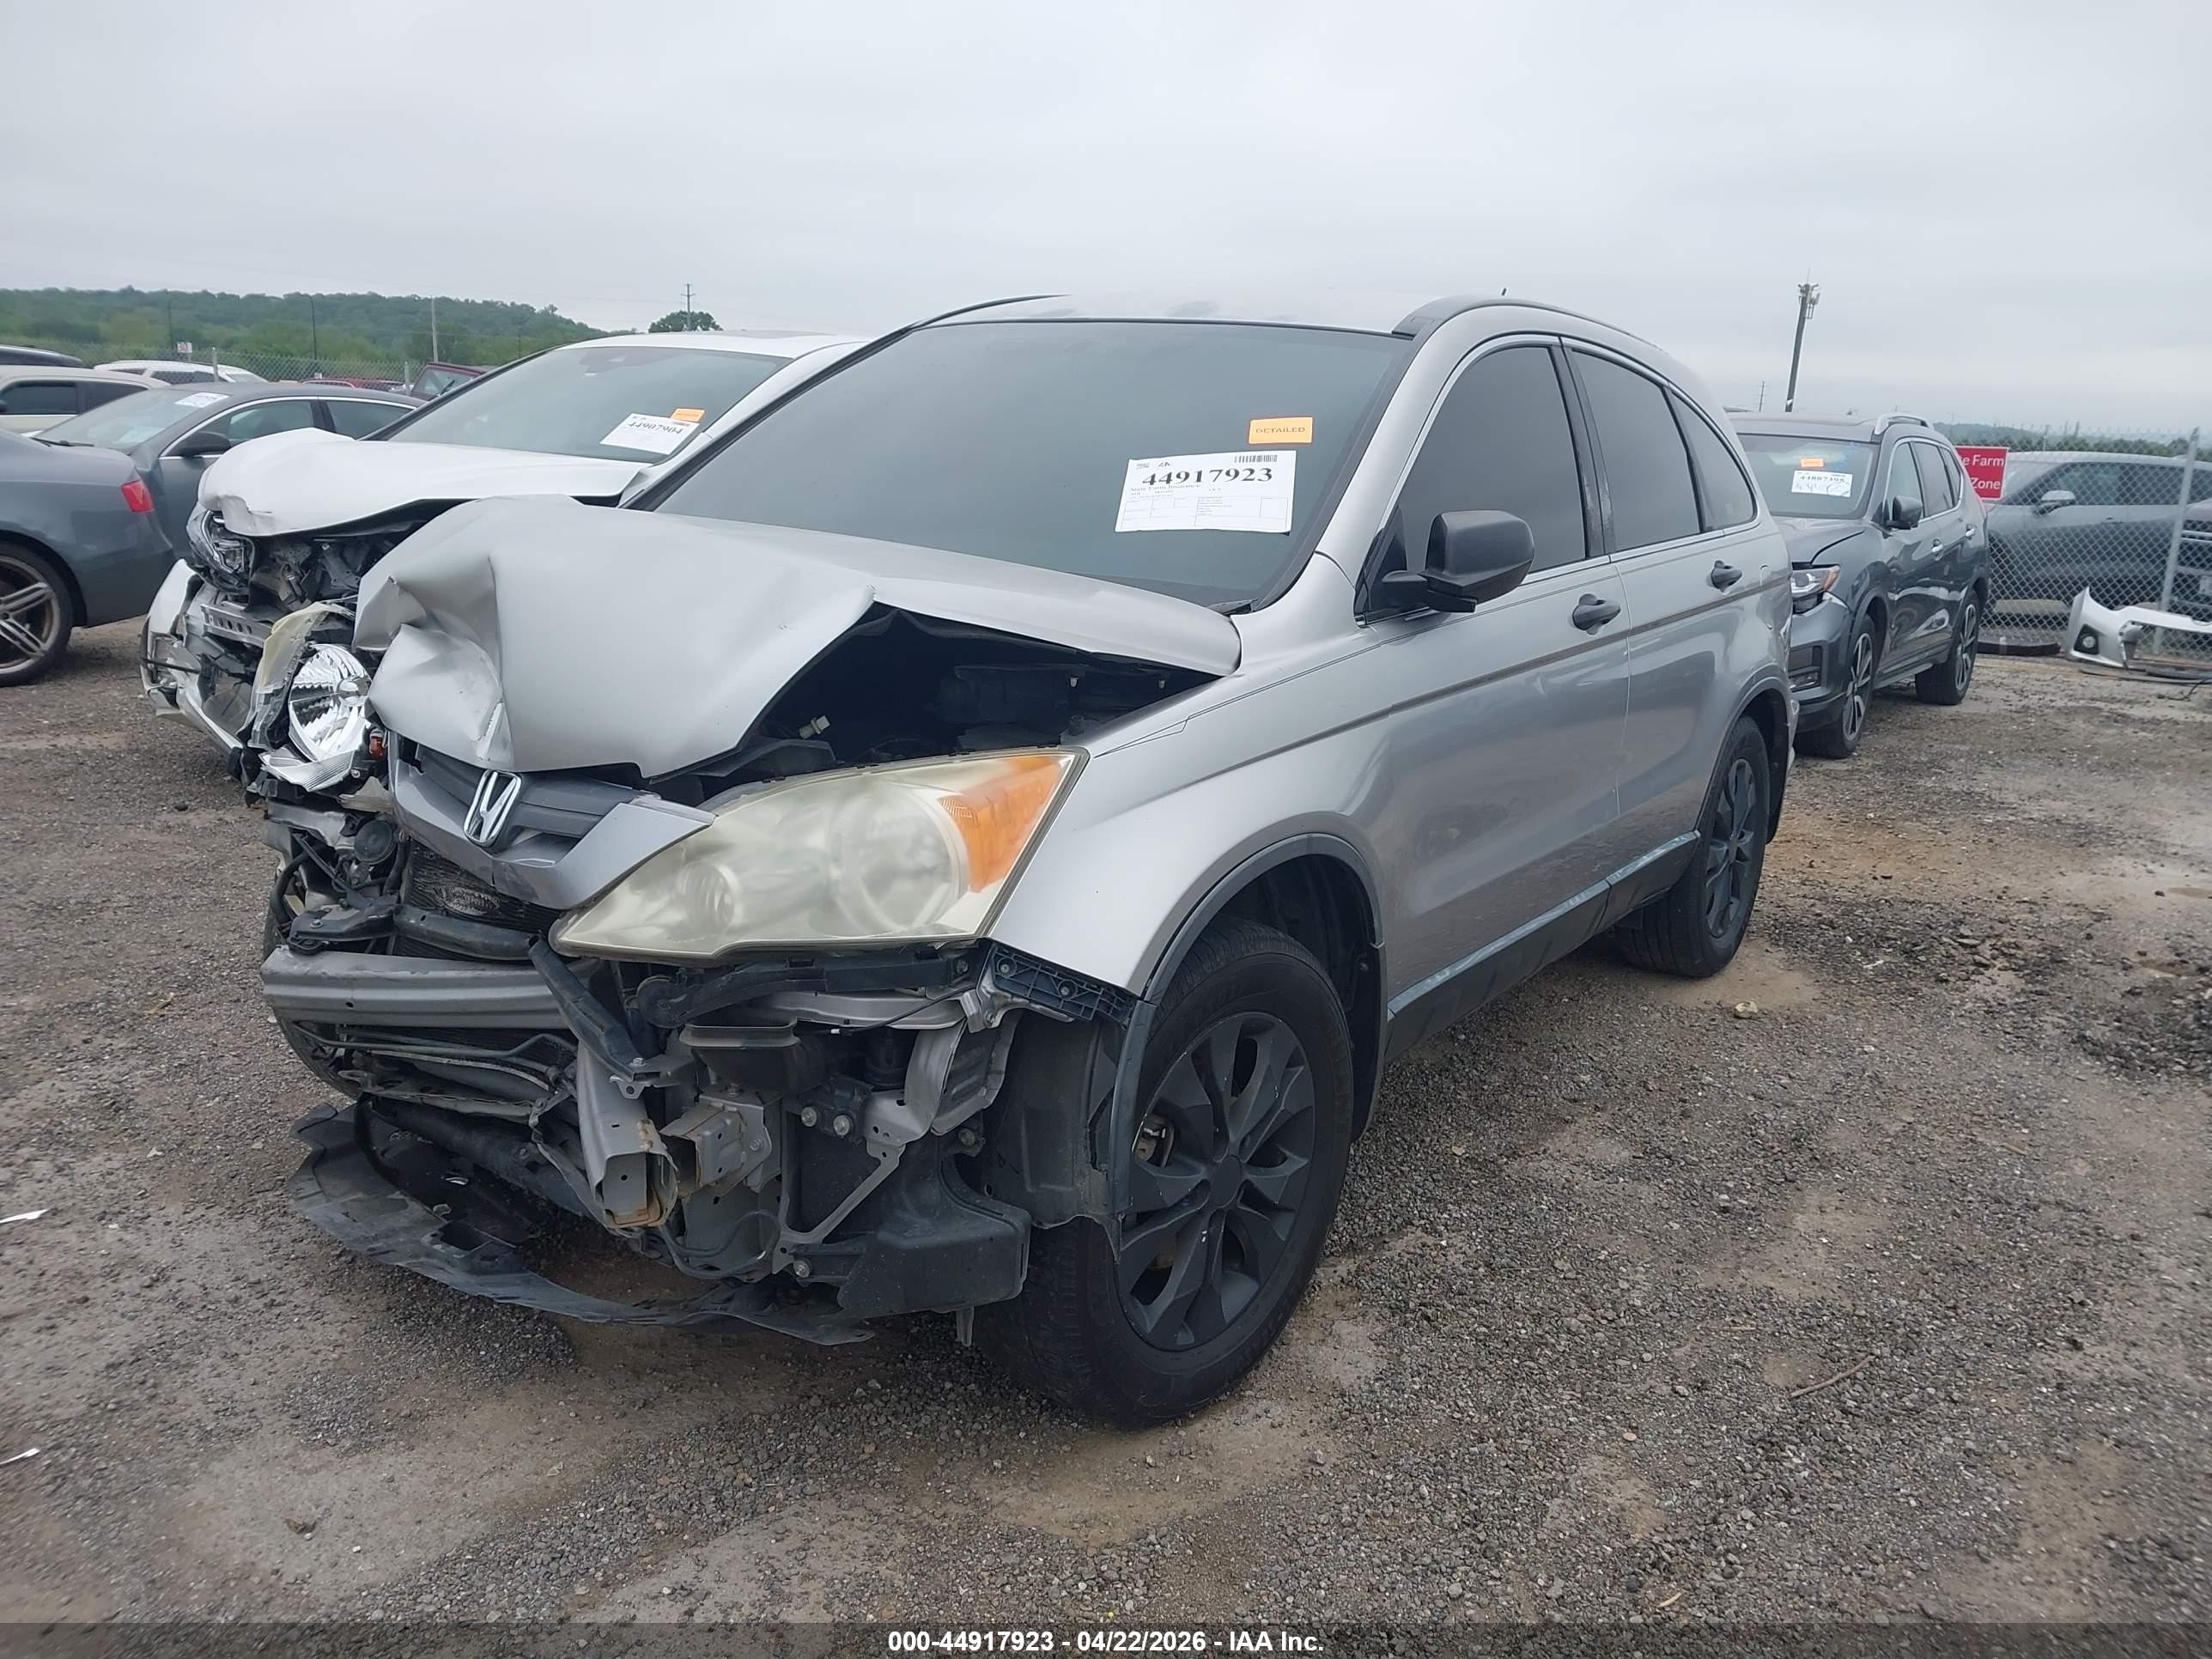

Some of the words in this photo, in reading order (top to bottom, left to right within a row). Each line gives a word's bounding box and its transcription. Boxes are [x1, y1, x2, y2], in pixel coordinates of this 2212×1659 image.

[1972, 454, 2004, 466] Farm
[1142, 468, 1273, 485] 44917923
[1971, 477, 2001, 489] Zone
